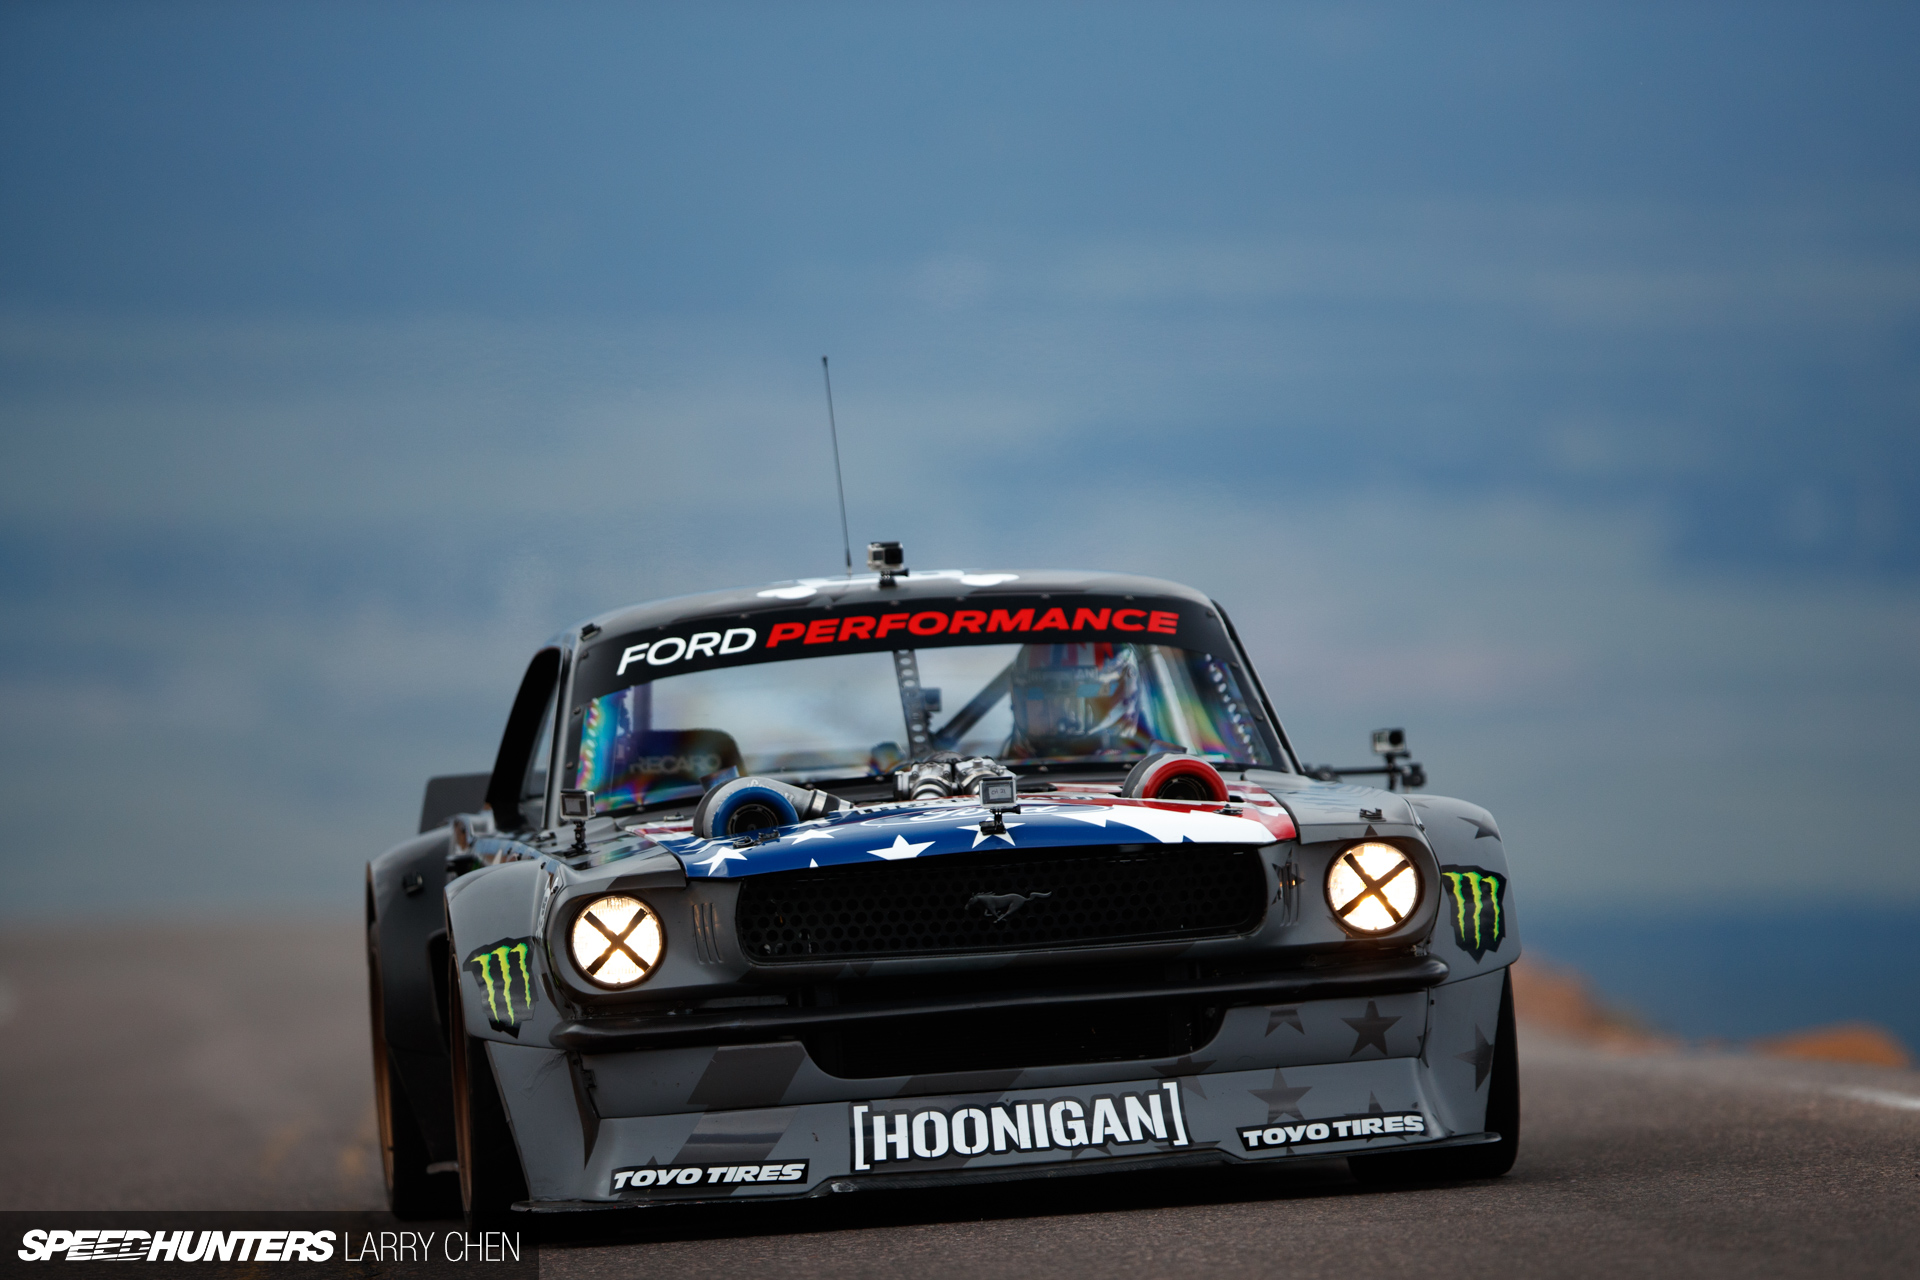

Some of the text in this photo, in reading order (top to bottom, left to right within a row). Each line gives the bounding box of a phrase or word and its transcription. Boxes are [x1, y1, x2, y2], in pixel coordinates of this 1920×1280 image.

[616, 607, 1180, 676] FORD PERFORMANCE
[853, 1082, 1189, 1170] [HOONIGAN]
[1243, 1115, 1425, 1147] TOYO TIRES
[613, 1163, 806, 1190] TOYO TIRES
